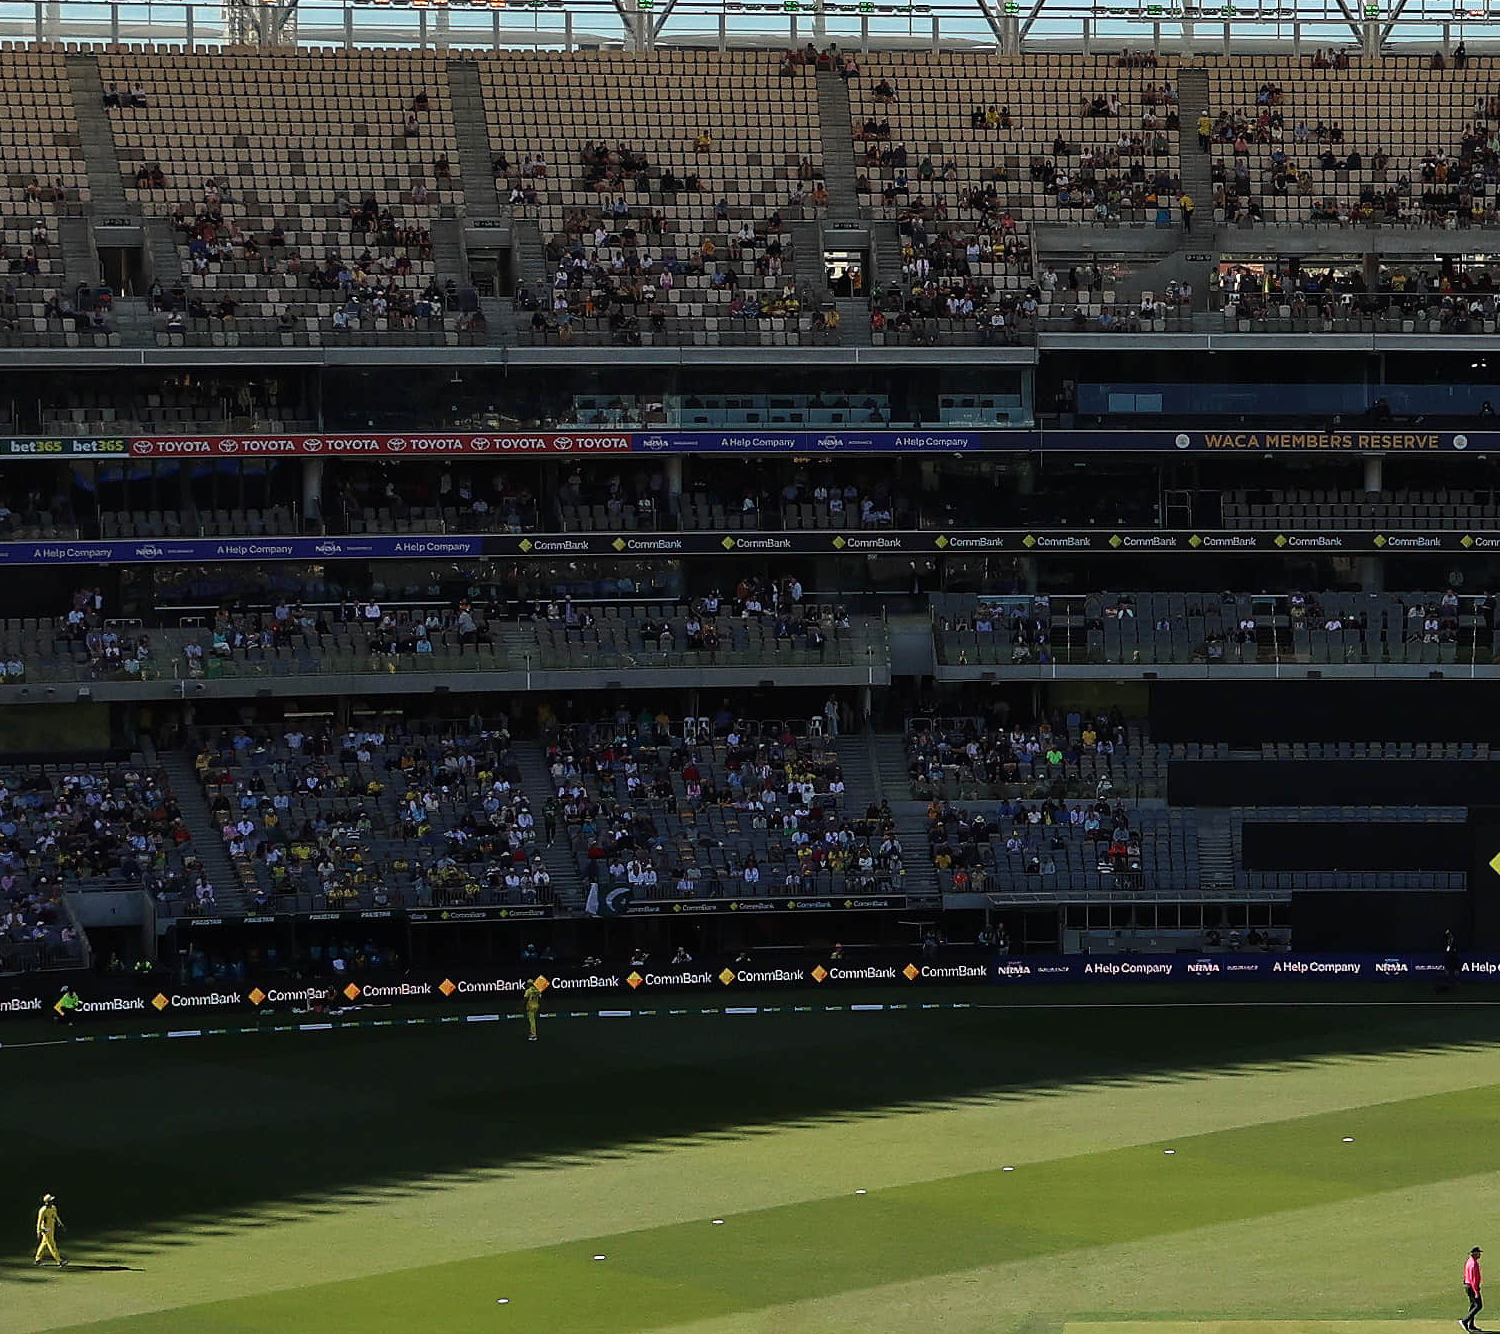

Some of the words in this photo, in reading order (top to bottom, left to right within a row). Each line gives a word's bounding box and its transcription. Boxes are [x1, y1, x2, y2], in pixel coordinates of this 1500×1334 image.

[73, 441, 125, 451] bet365
[156, 441, 210, 452] TOYOTA
[242, 441, 295, 450] TOYOTA
[410, 440, 462, 449] TOYOTA
[493, 438, 546, 448] TOYOTA
[730, 438, 751, 448] Help
[752, 438, 794, 448] Company
[1204, 435, 1261, 447] WACA
[1266, 435, 1352, 447] MEMBERS
[1359, 435, 1438, 448] RESERVE
[535, 540, 588, 550] CommBank
[737, 538, 790, 548] CommBank
[848, 537, 900, 548] CommBank
[1037, 536, 1090, 547] CommBank
[1124, 536, 1176, 546] CommBank
[1289, 536, 1341, 546] CommBank
[1389, 536, 1440, 547] CommBank
[403, 542, 426, 554] Help
[427, 542, 470, 552] Company
[921, 965, 987, 977] CommBank
[998, 966, 1030, 975] NRMA
[1085, 964, 1092, 973] A
[1093, 963, 1120, 974] Help
[1121, 963, 1172, 973] Company
[1188, 964, 1219, 972] NRMA
[1273, 962, 1282, 971] A
[1283, 962, 1309, 972] Help
[1310, 962, 1360, 972] Company
[1376, 963, 1408, 972] NRMA
[1462, 962, 1470, 971] A
[1471, 962, 1496, 972] Help
[645, 972, 712, 984] CommBank
[738, 970, 803, 981] CommBank
[830, 968, 895, 978] CommBank
[458, 979, 526, 992] CommBank
[551, 976, 619, 988] CommBank
[363, 983, 431, 997] CommBank
[171, 992, 240, 1006] CommBank
